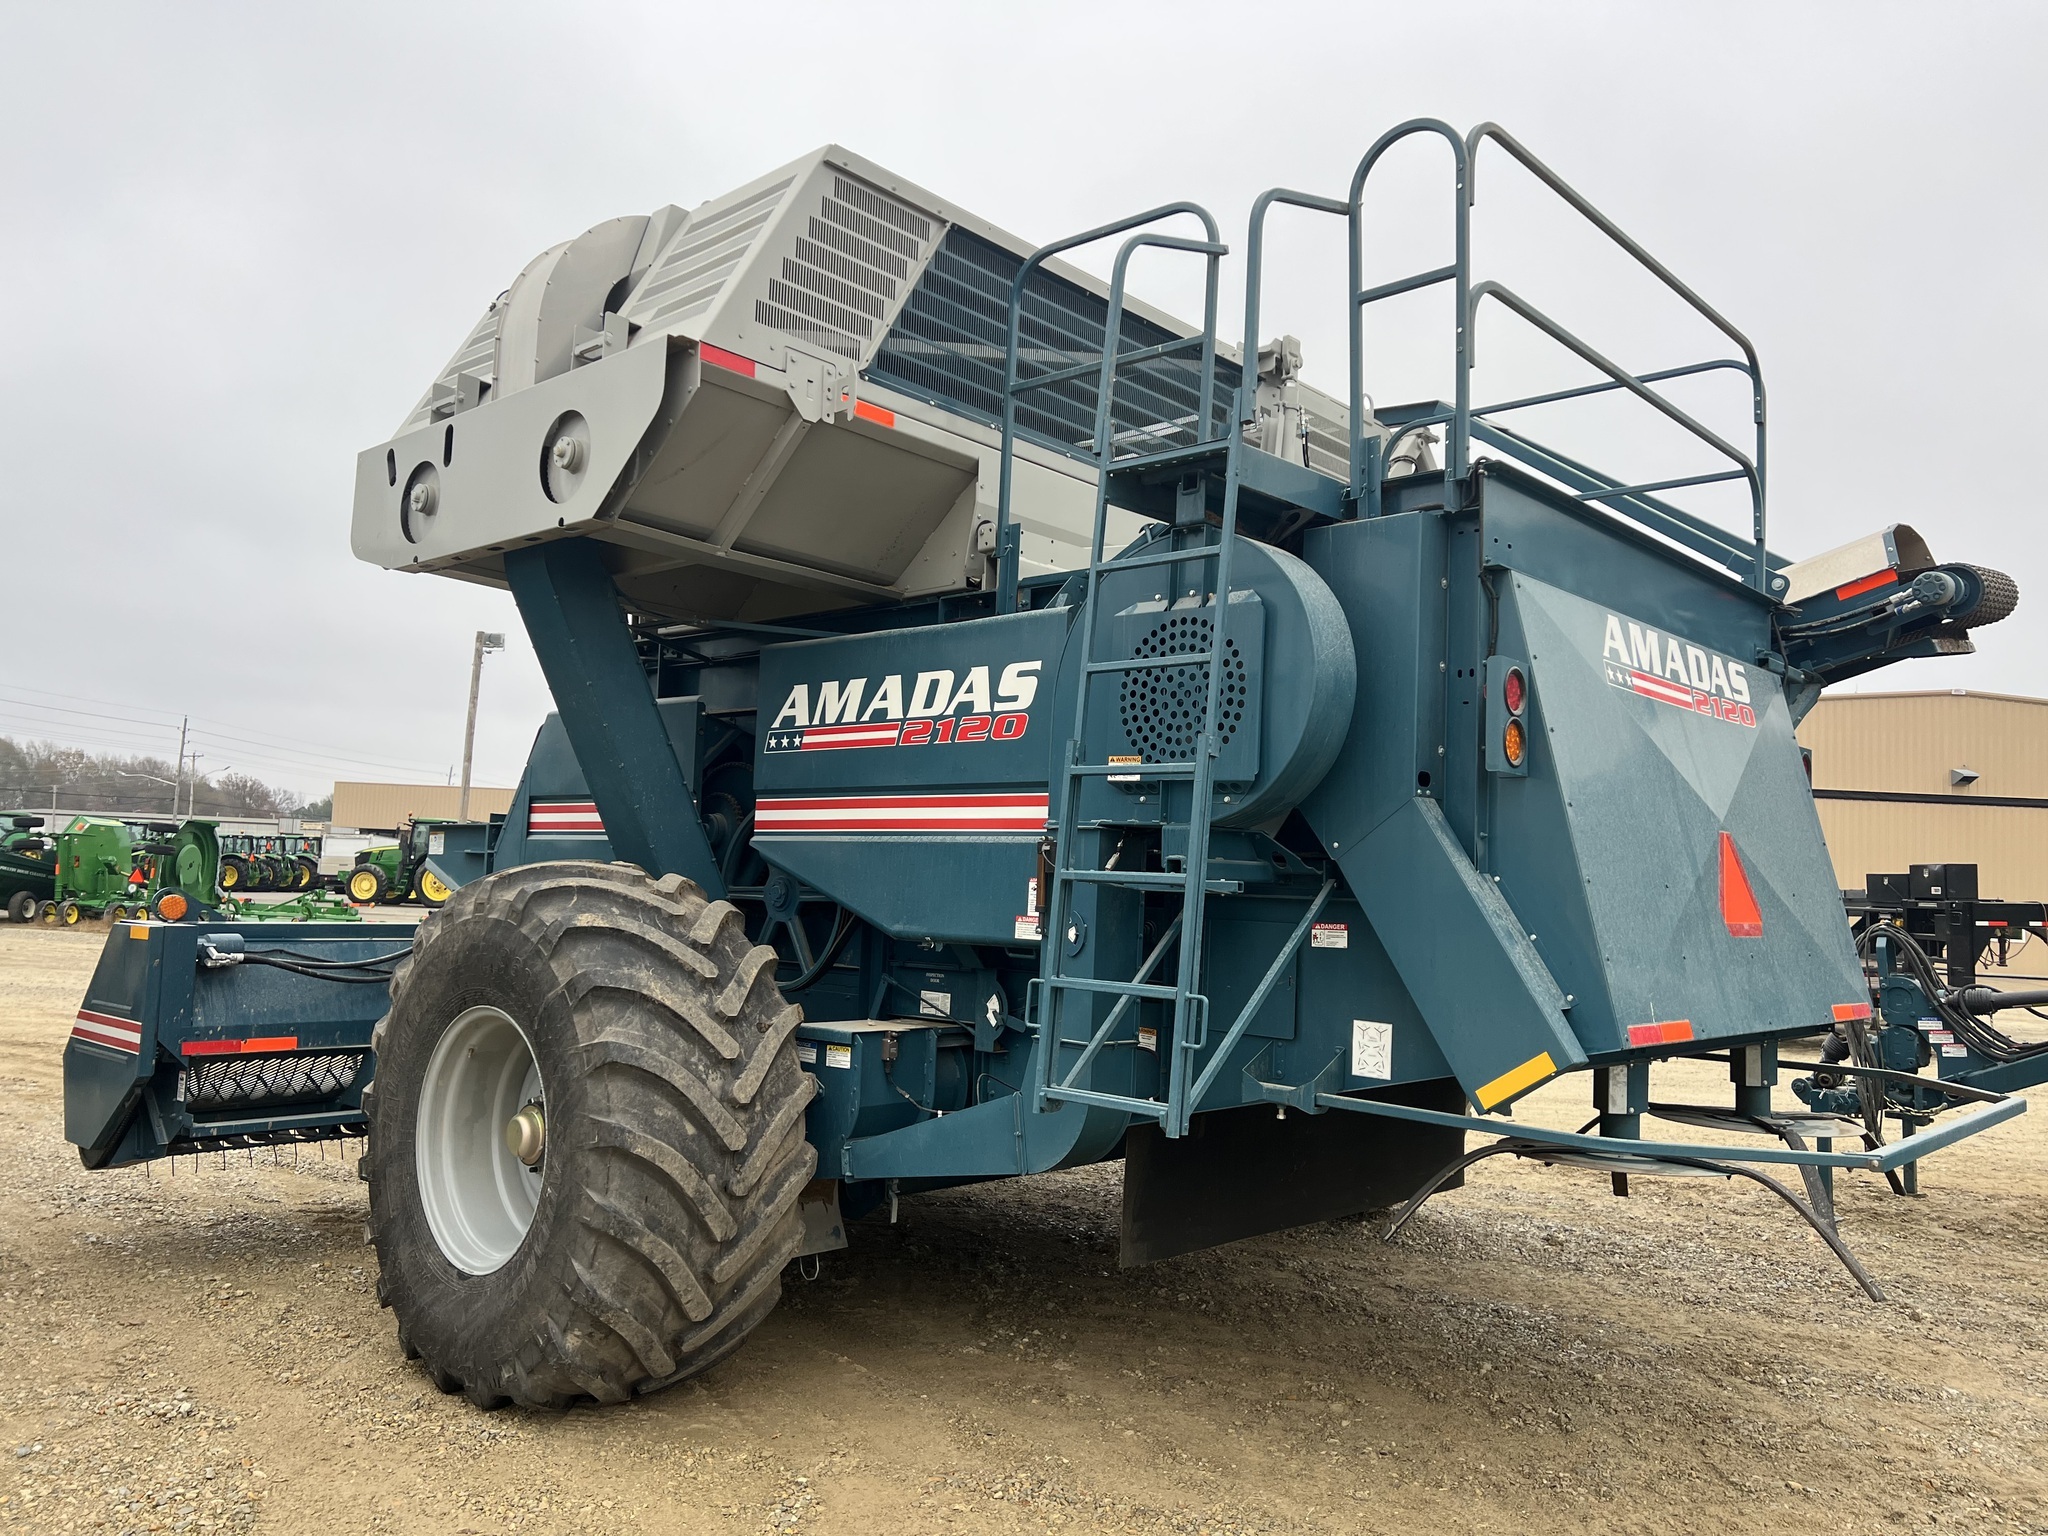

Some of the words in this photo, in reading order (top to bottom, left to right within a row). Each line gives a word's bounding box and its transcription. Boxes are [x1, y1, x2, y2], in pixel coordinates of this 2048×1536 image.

[1603, 614, 1751, 704] AMADAS
[771, 660, 1042, 728] AMADAS
[1692, 690, 1757, 729] 2120
[899, 713, 1030, 746] 2120
